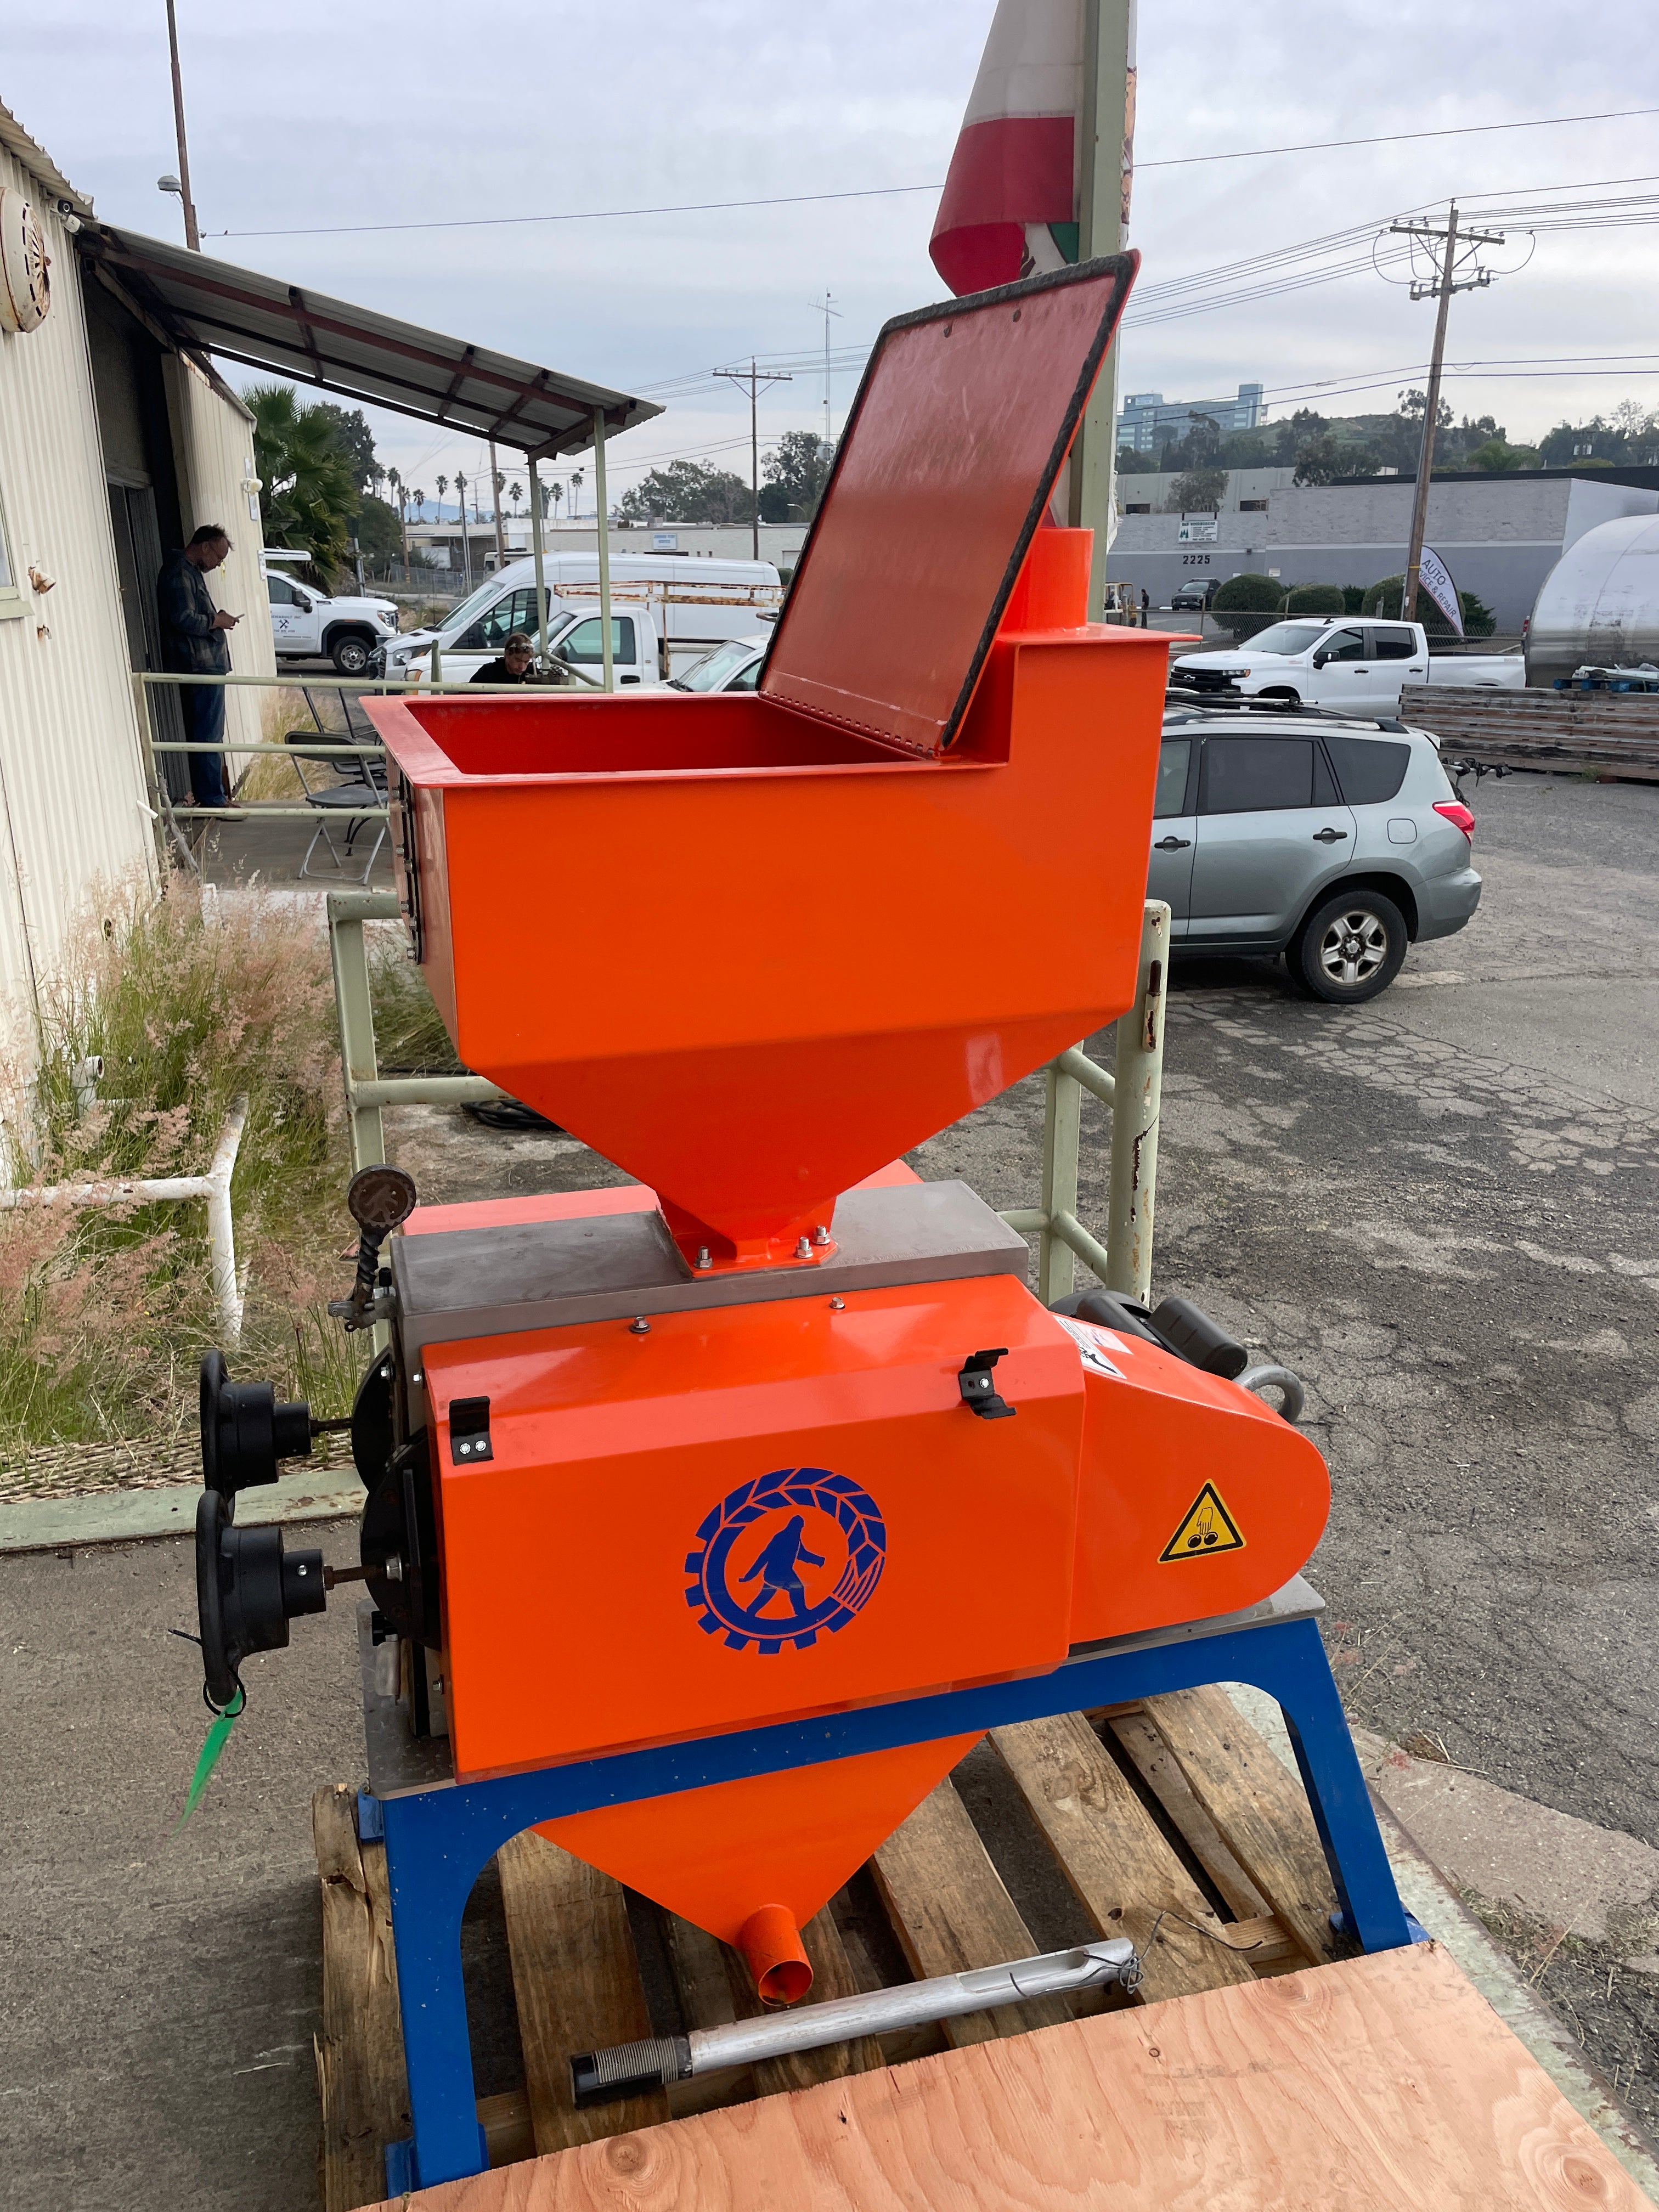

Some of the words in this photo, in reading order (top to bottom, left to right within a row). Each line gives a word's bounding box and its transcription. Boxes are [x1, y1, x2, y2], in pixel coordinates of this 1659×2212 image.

[1183, 555, 1210, 565] 2225
[1422, 559, 1446, 585] AUTO
[1419, 568, 1434, 588] VICE
[1431, 586, 1438, 595] &
[1437, 592, 1457, 618] REPAIR
